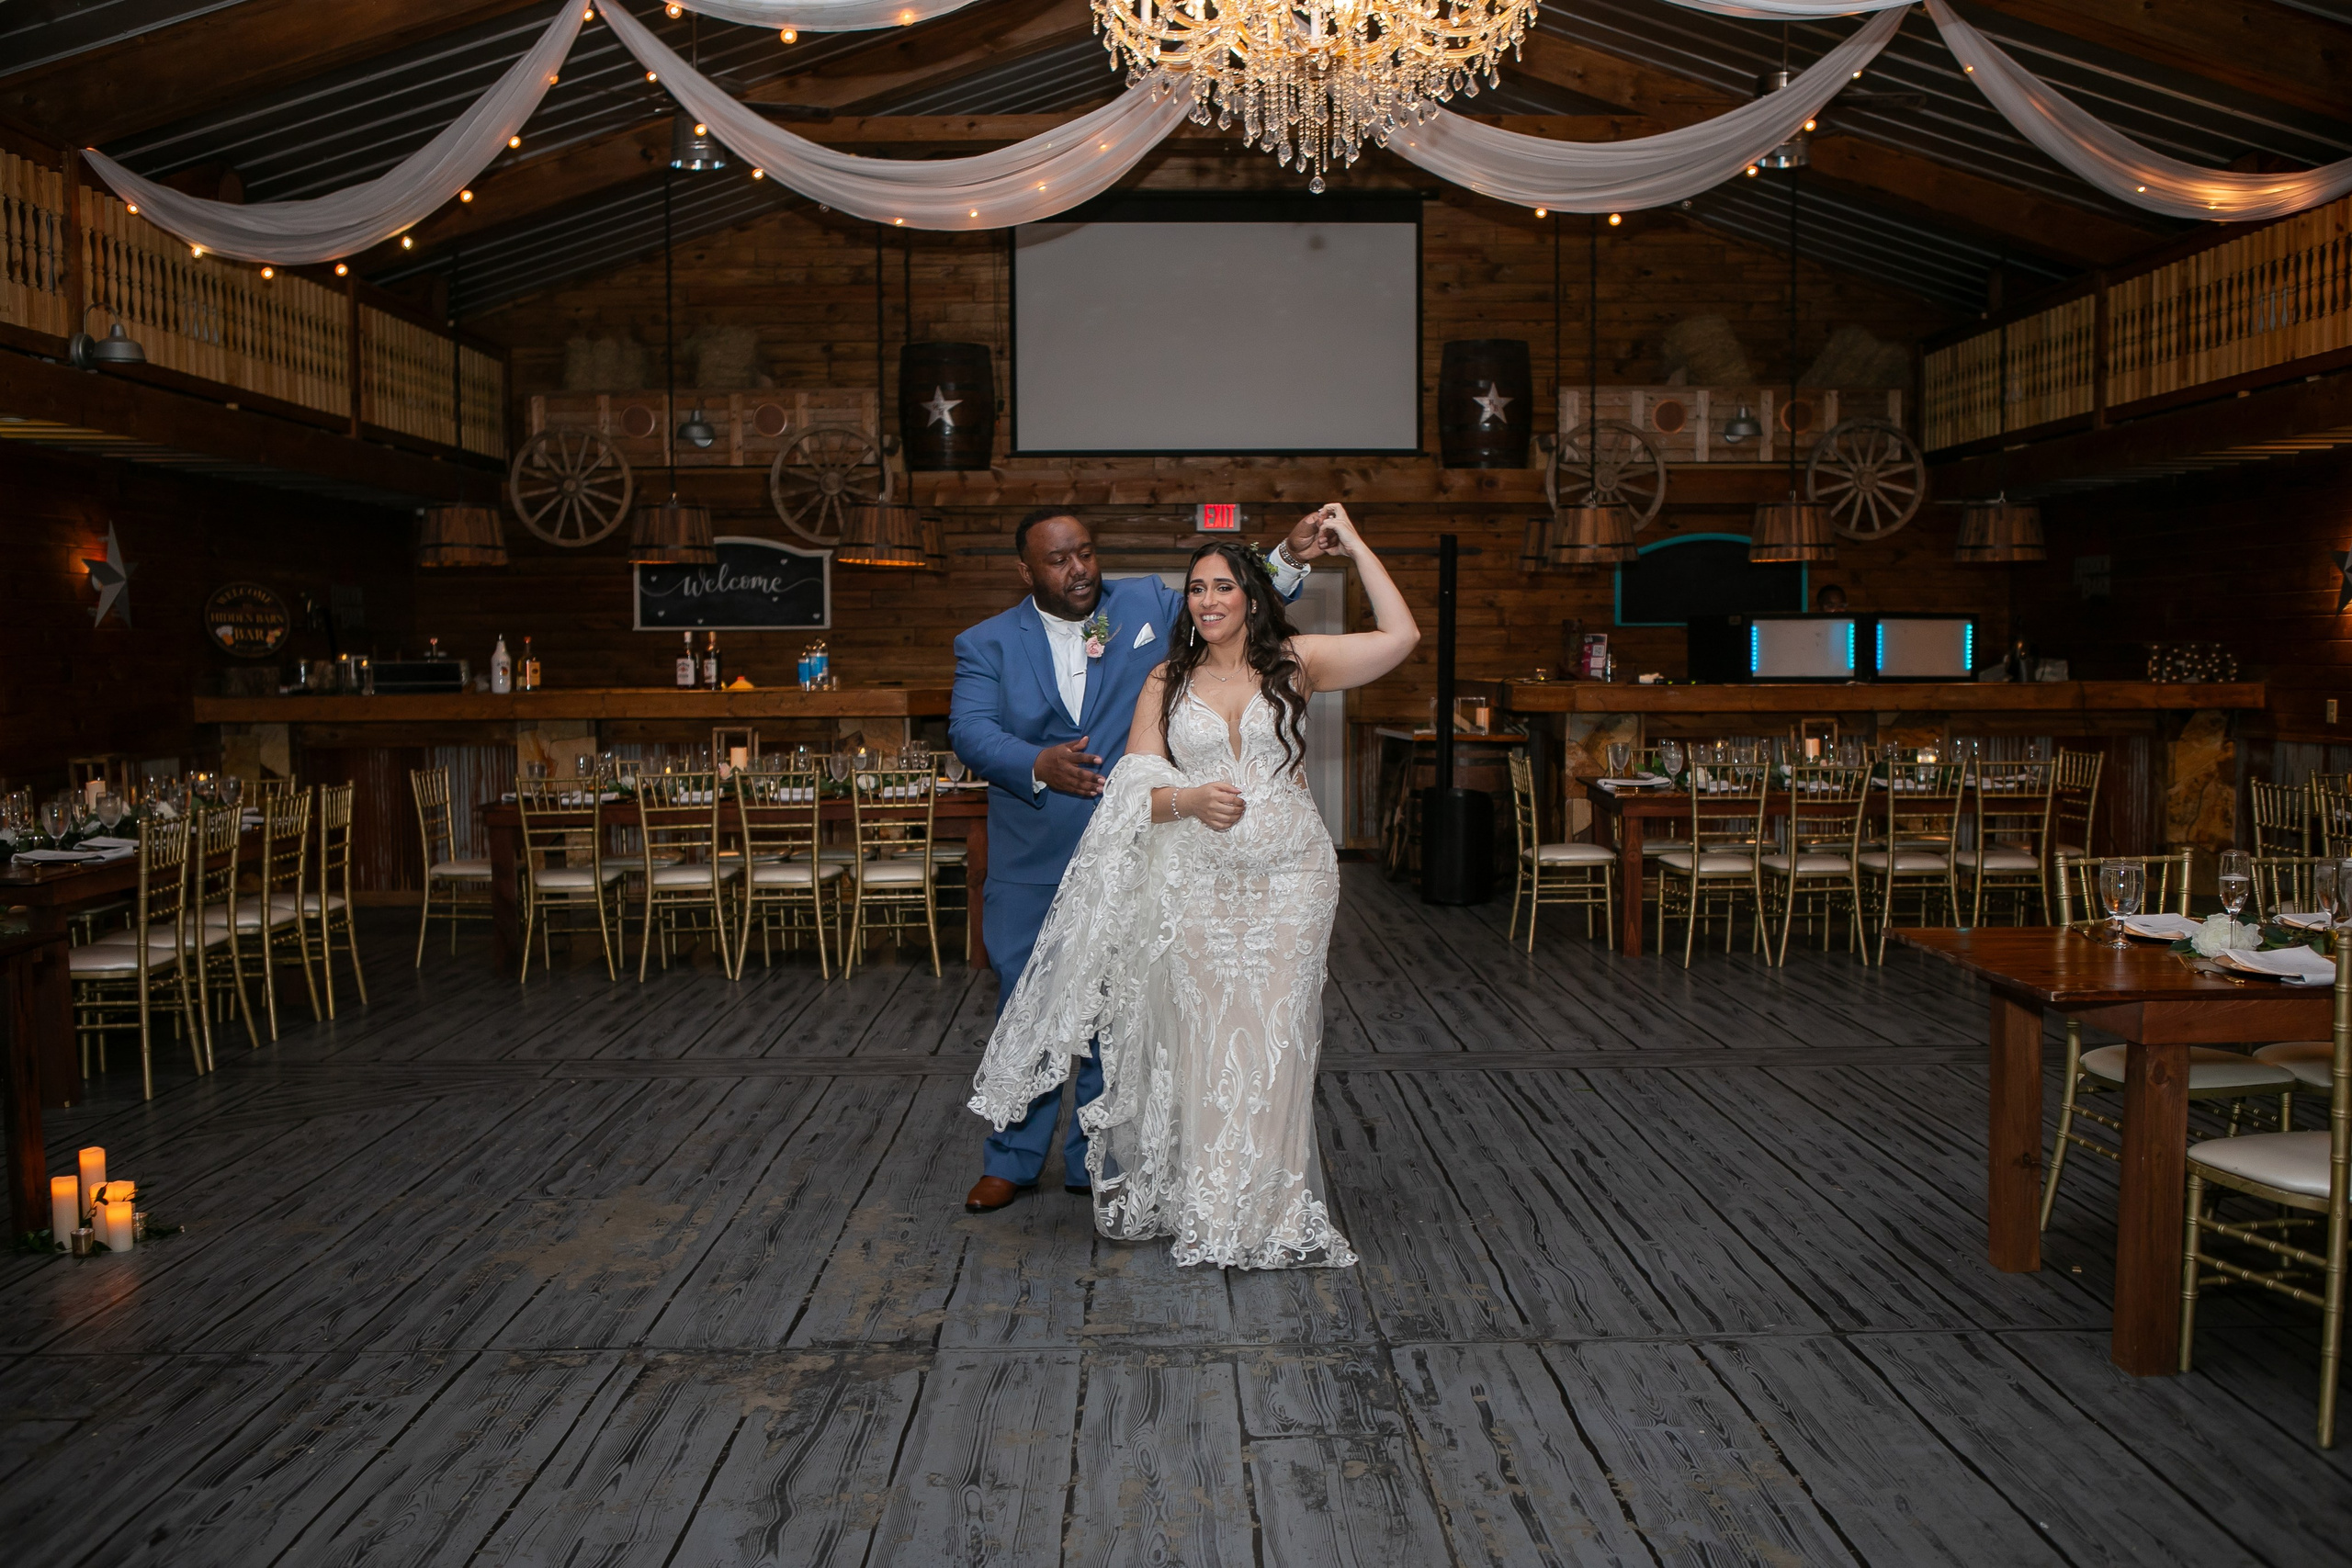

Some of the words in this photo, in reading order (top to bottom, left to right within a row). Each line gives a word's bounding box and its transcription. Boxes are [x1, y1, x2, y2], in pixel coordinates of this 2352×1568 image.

[1204, 503, 1237, 529] EXIT
[216, 588, 273, 604] WELCOME
[210, 612, 254, 624] HIDDEN
[255, 613, 284, 625] BARN
[233, 627, 265, 641] BAR
